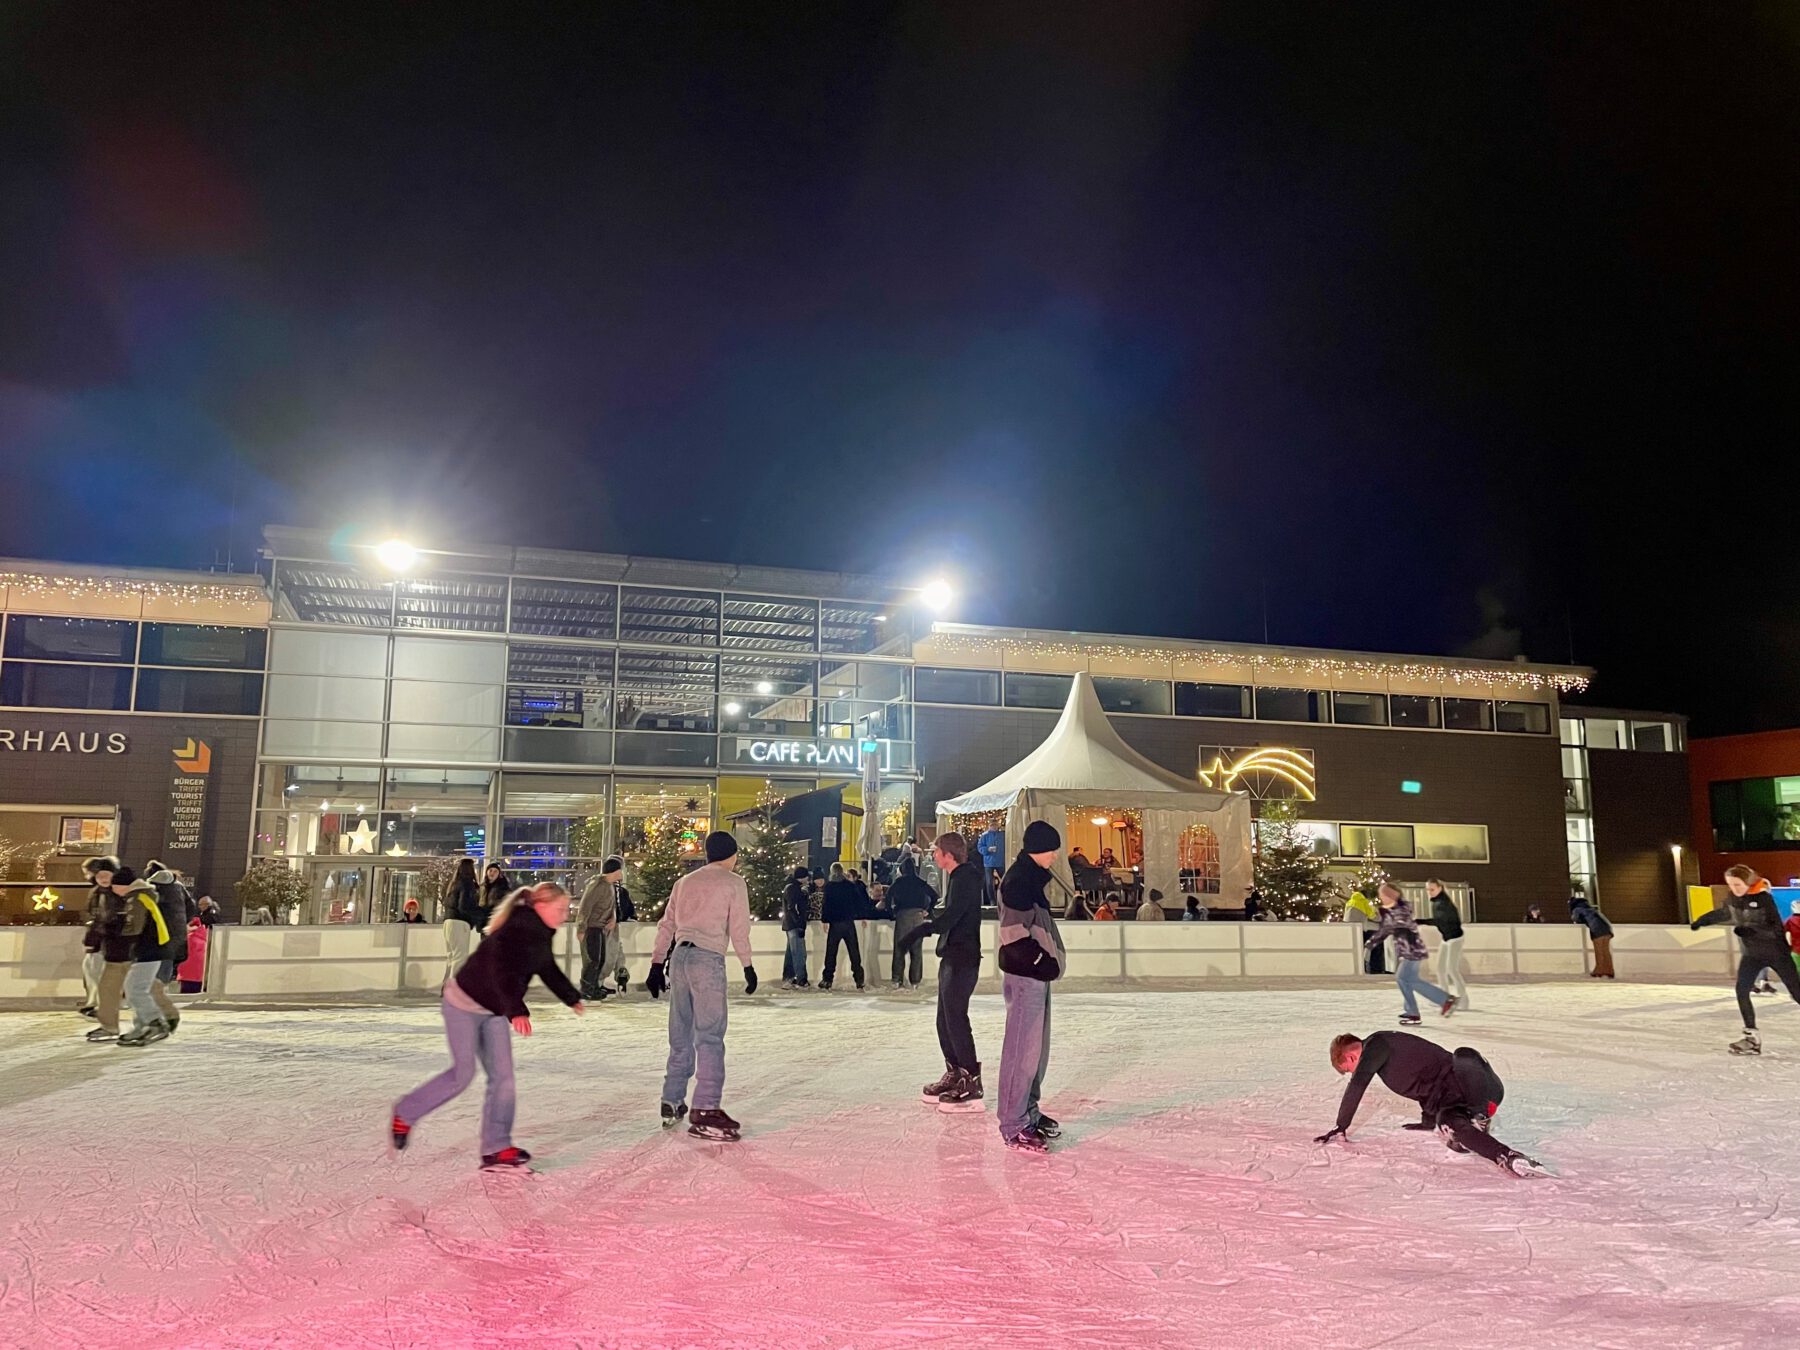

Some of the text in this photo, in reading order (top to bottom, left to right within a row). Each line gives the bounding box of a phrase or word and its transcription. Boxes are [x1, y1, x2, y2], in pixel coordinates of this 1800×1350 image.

[749, 741, 853, 764] CAFÉ PLAN
[174, 777, 204, 785] BÜRGER
